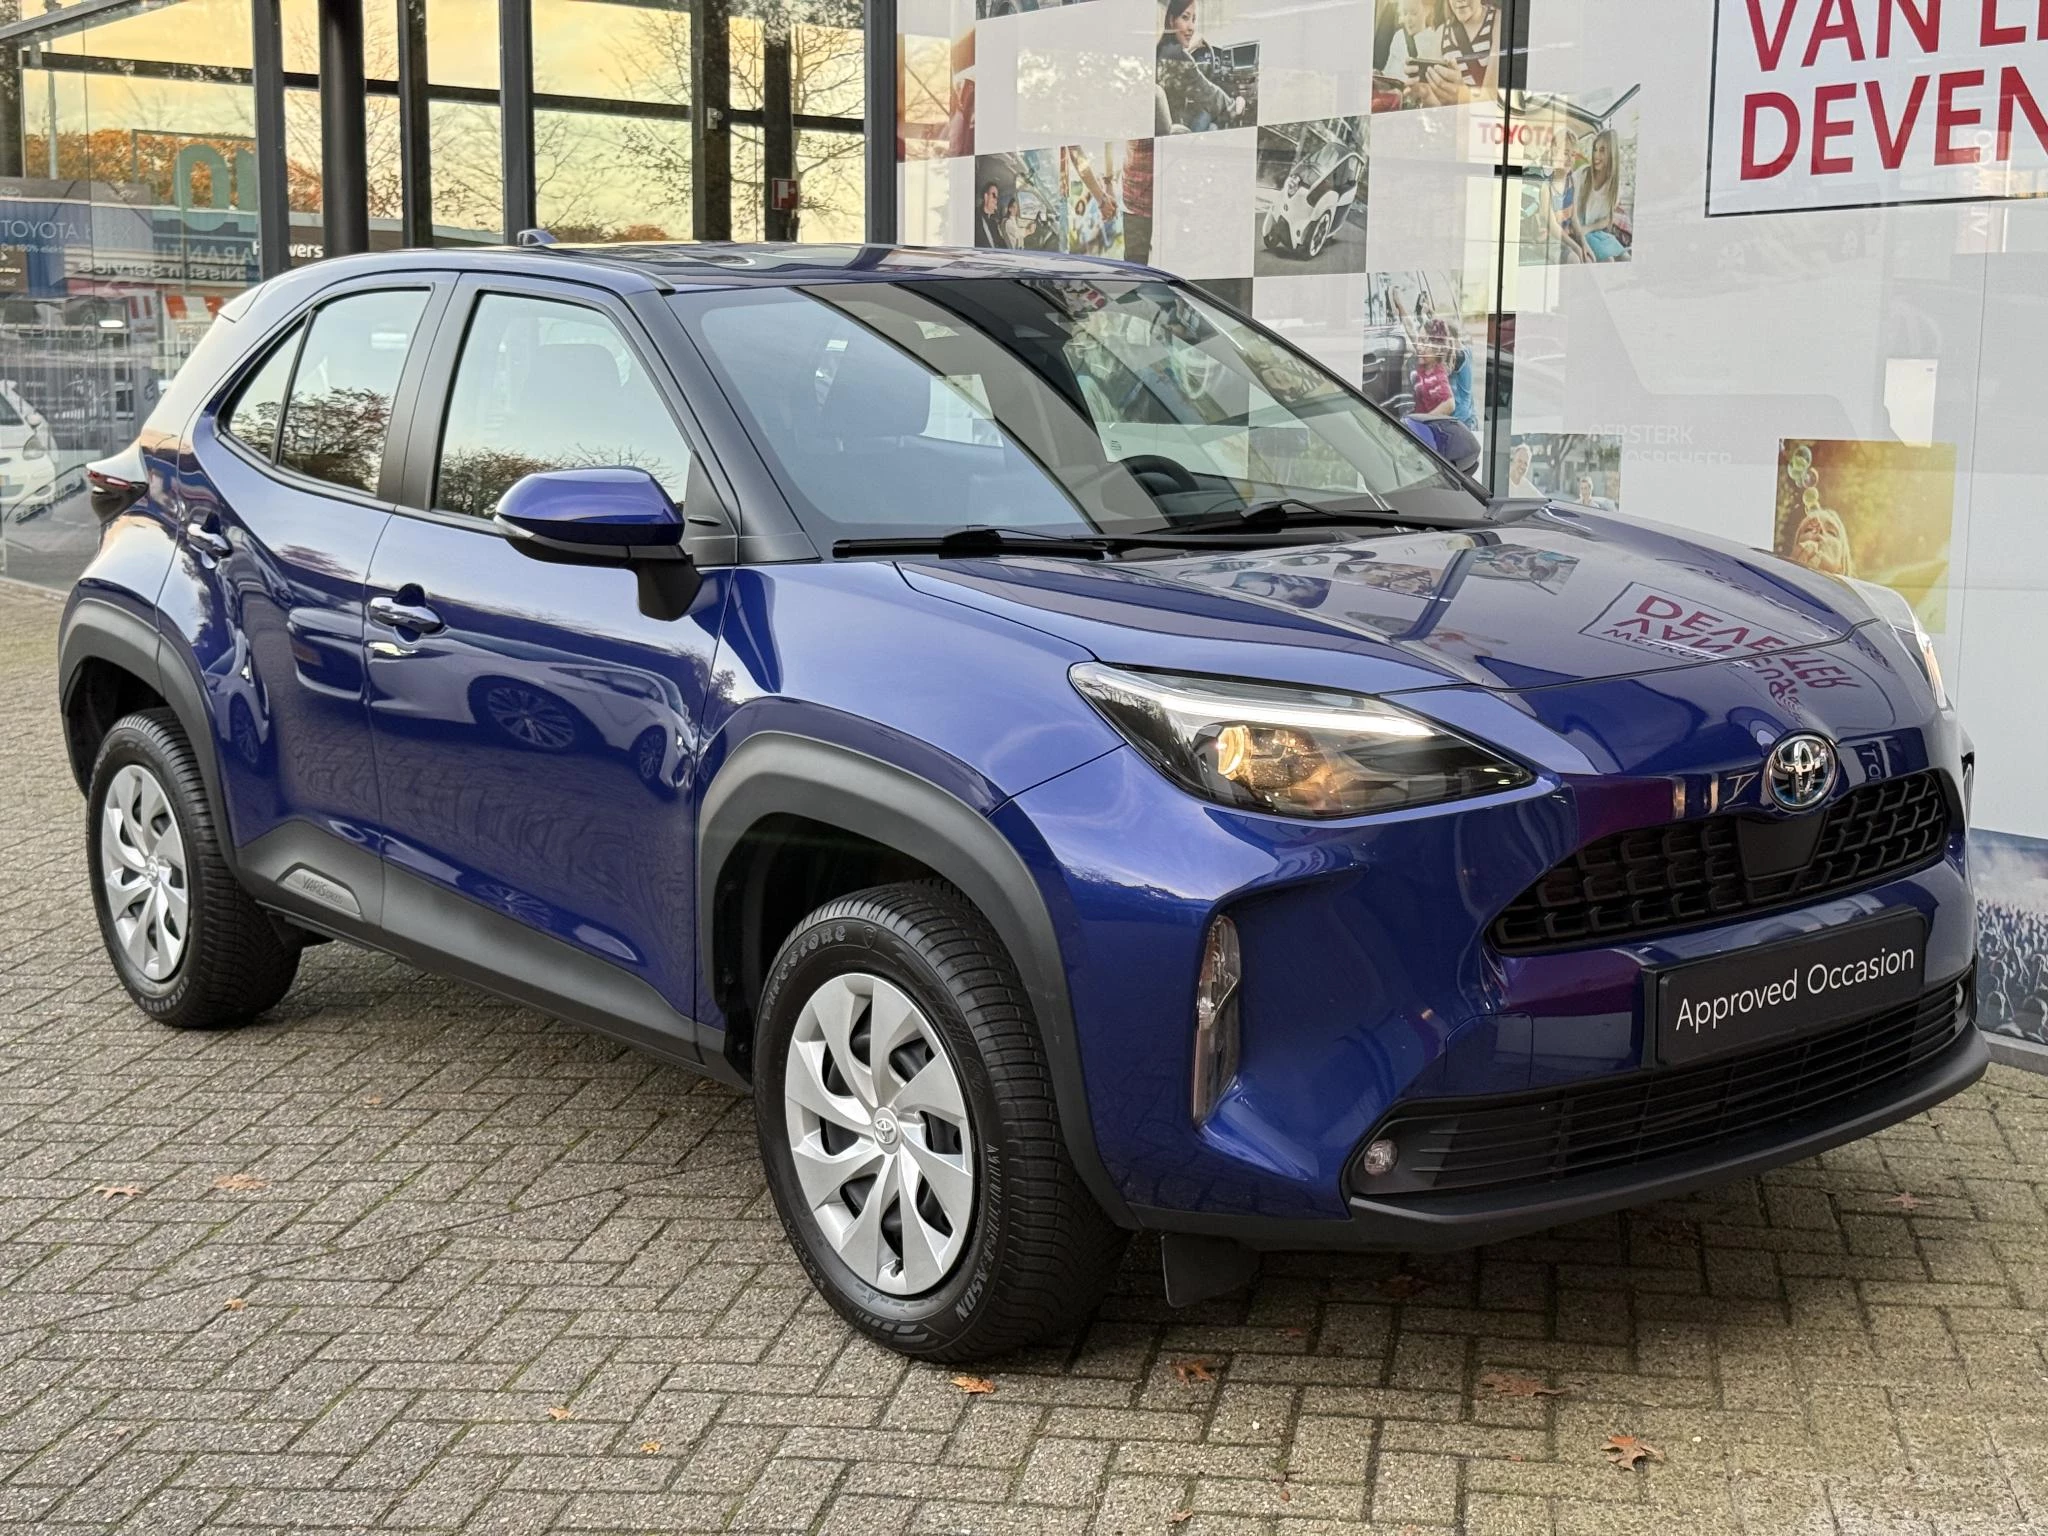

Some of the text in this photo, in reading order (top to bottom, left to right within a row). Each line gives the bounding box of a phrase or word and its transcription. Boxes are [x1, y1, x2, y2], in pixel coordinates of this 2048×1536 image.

[1746, 0, 1940, 72] VAN
[1477, 122, 1556, 146] TOYOTA
[1740, 66, 2048, 181] DEVEN
[2, 220, 79, 240] TOYOTA
[1675, 947, 1914, 1033] Approved Occasion
